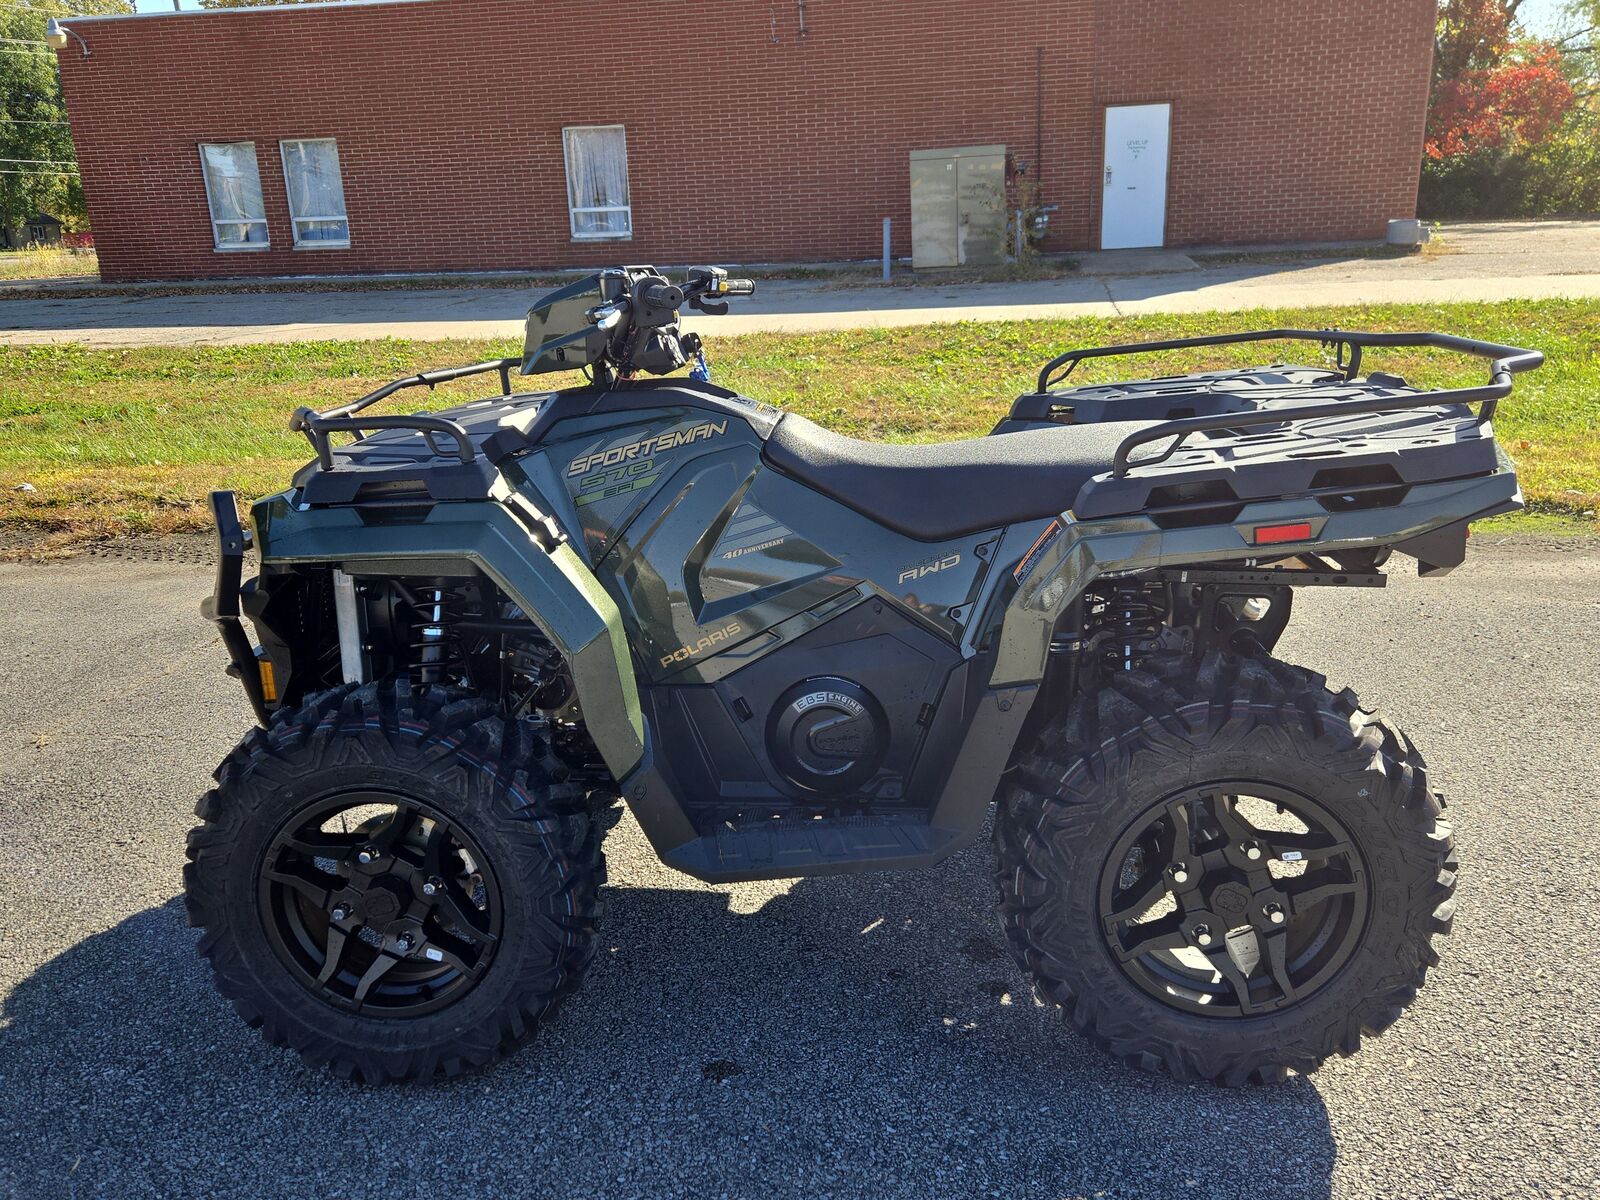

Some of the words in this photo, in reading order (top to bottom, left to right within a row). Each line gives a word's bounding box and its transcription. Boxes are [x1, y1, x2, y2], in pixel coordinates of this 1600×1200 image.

[567, 420, 728, 477] SPORTSMAN
[579, 458, 654, 491] 570
[603, 482, 634, 497] EFI
[722, 549, 743, 560] 40
[743, 538, 784, 555] ANNIVERSARY
[898, 554, 960, 584] AWD
[660, 622, 741, 668] POLARIS
[797, 693, 825, 710] EBS
[828, 693, 862, 712] ENGINE
